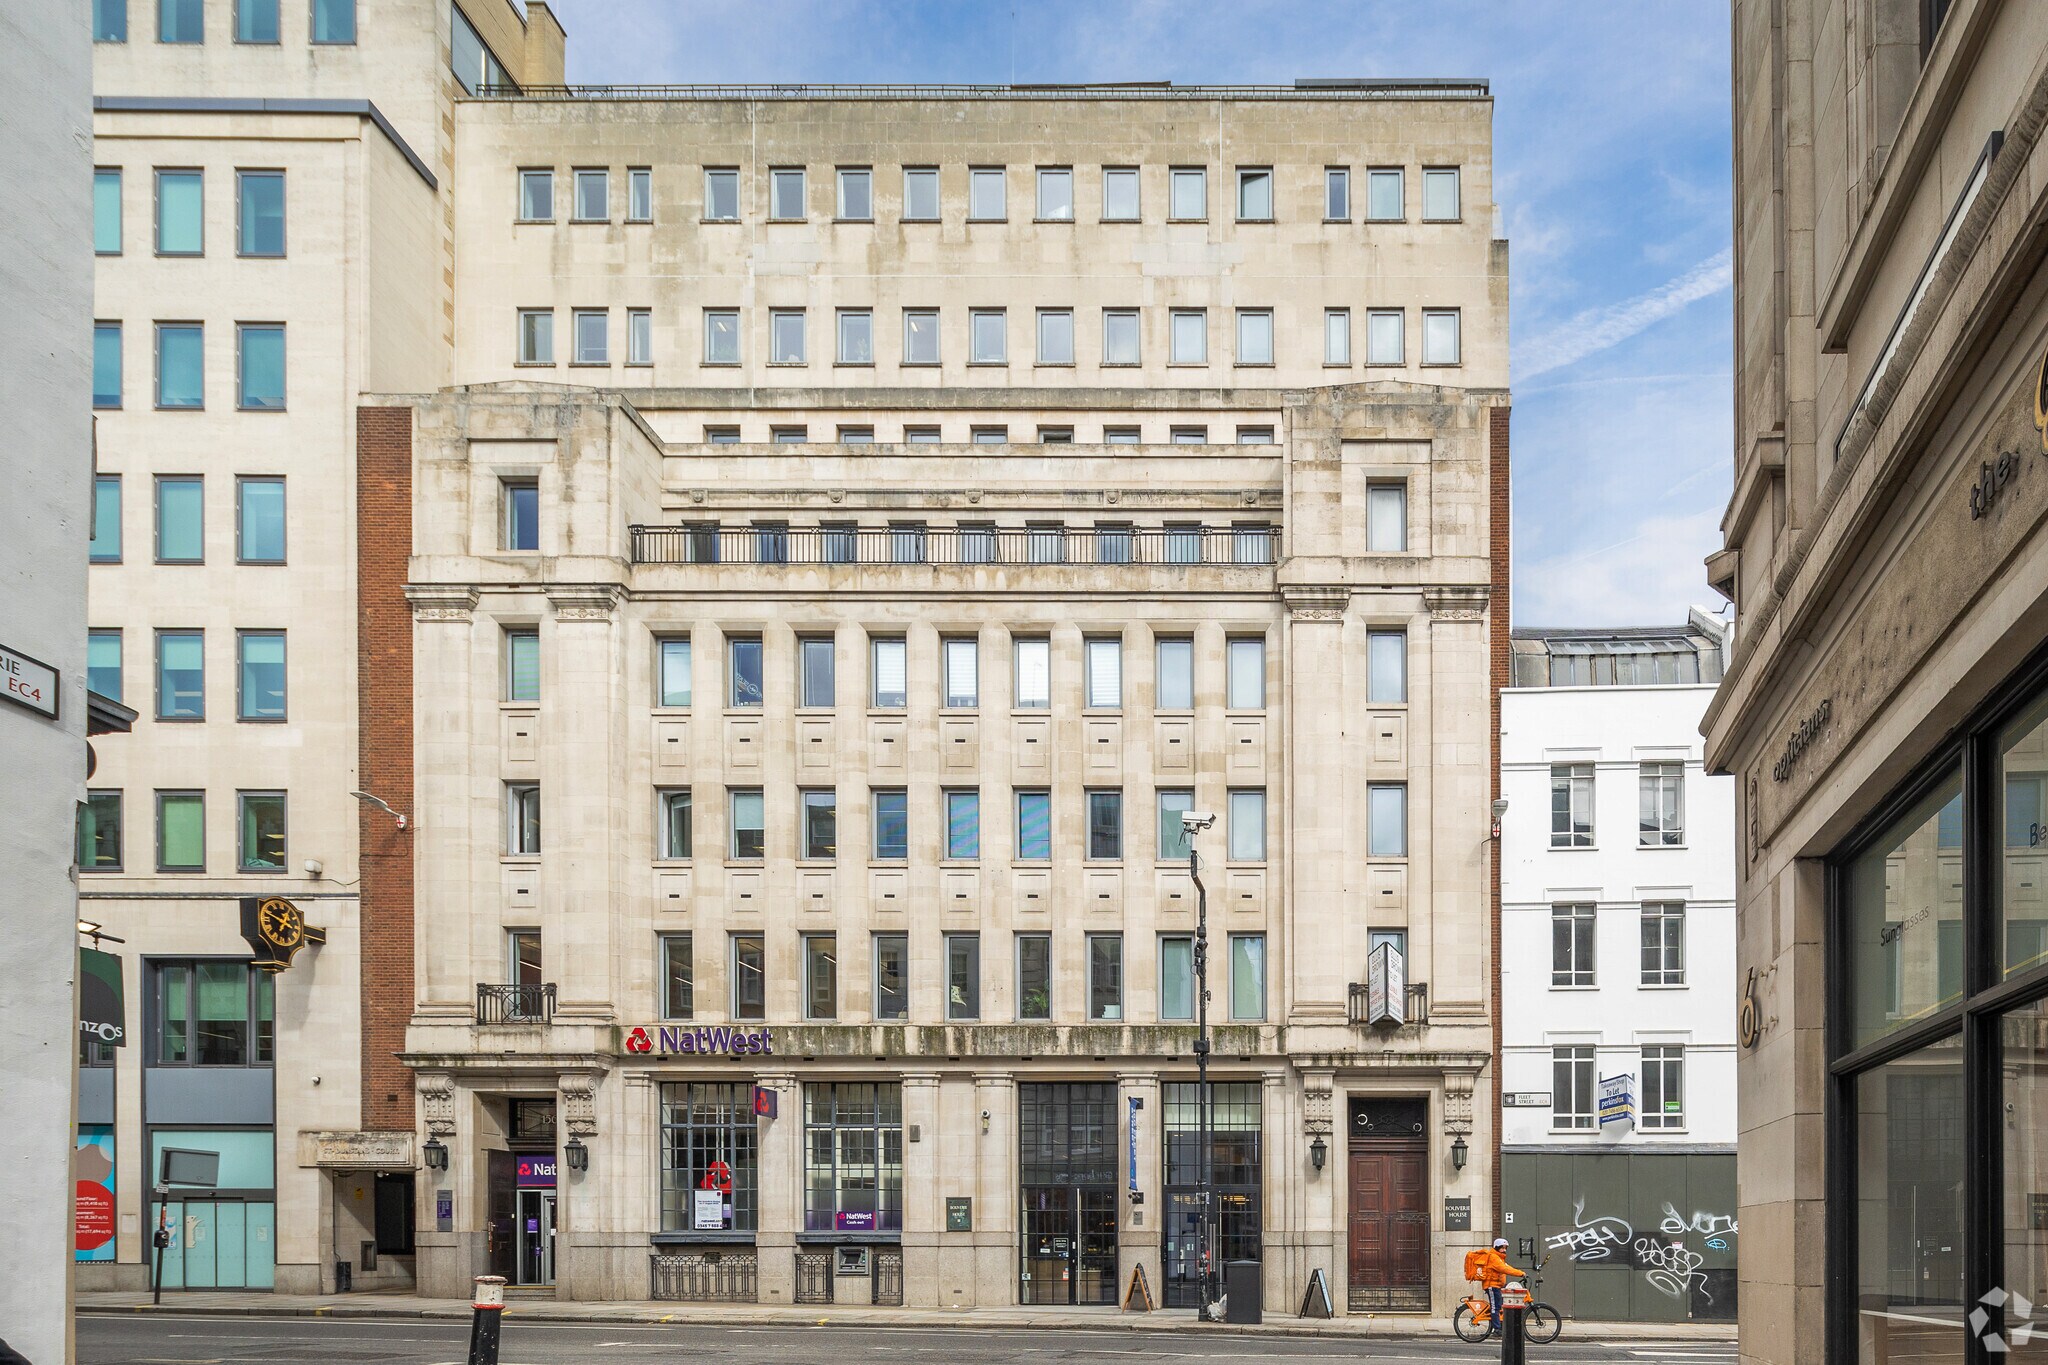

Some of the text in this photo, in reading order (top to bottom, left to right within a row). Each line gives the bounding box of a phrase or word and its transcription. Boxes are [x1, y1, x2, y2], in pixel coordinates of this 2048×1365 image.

[1969, 451, 2011, 521] the
[9, 677, 41, 702] EC4
[1773, 700, 1830, 782] opticians
[1880, 906, 1930, 947] Sunglasses
[660, 1026, 773, 1054] NatWest
[534, 1164, 556, 1175] Nat
